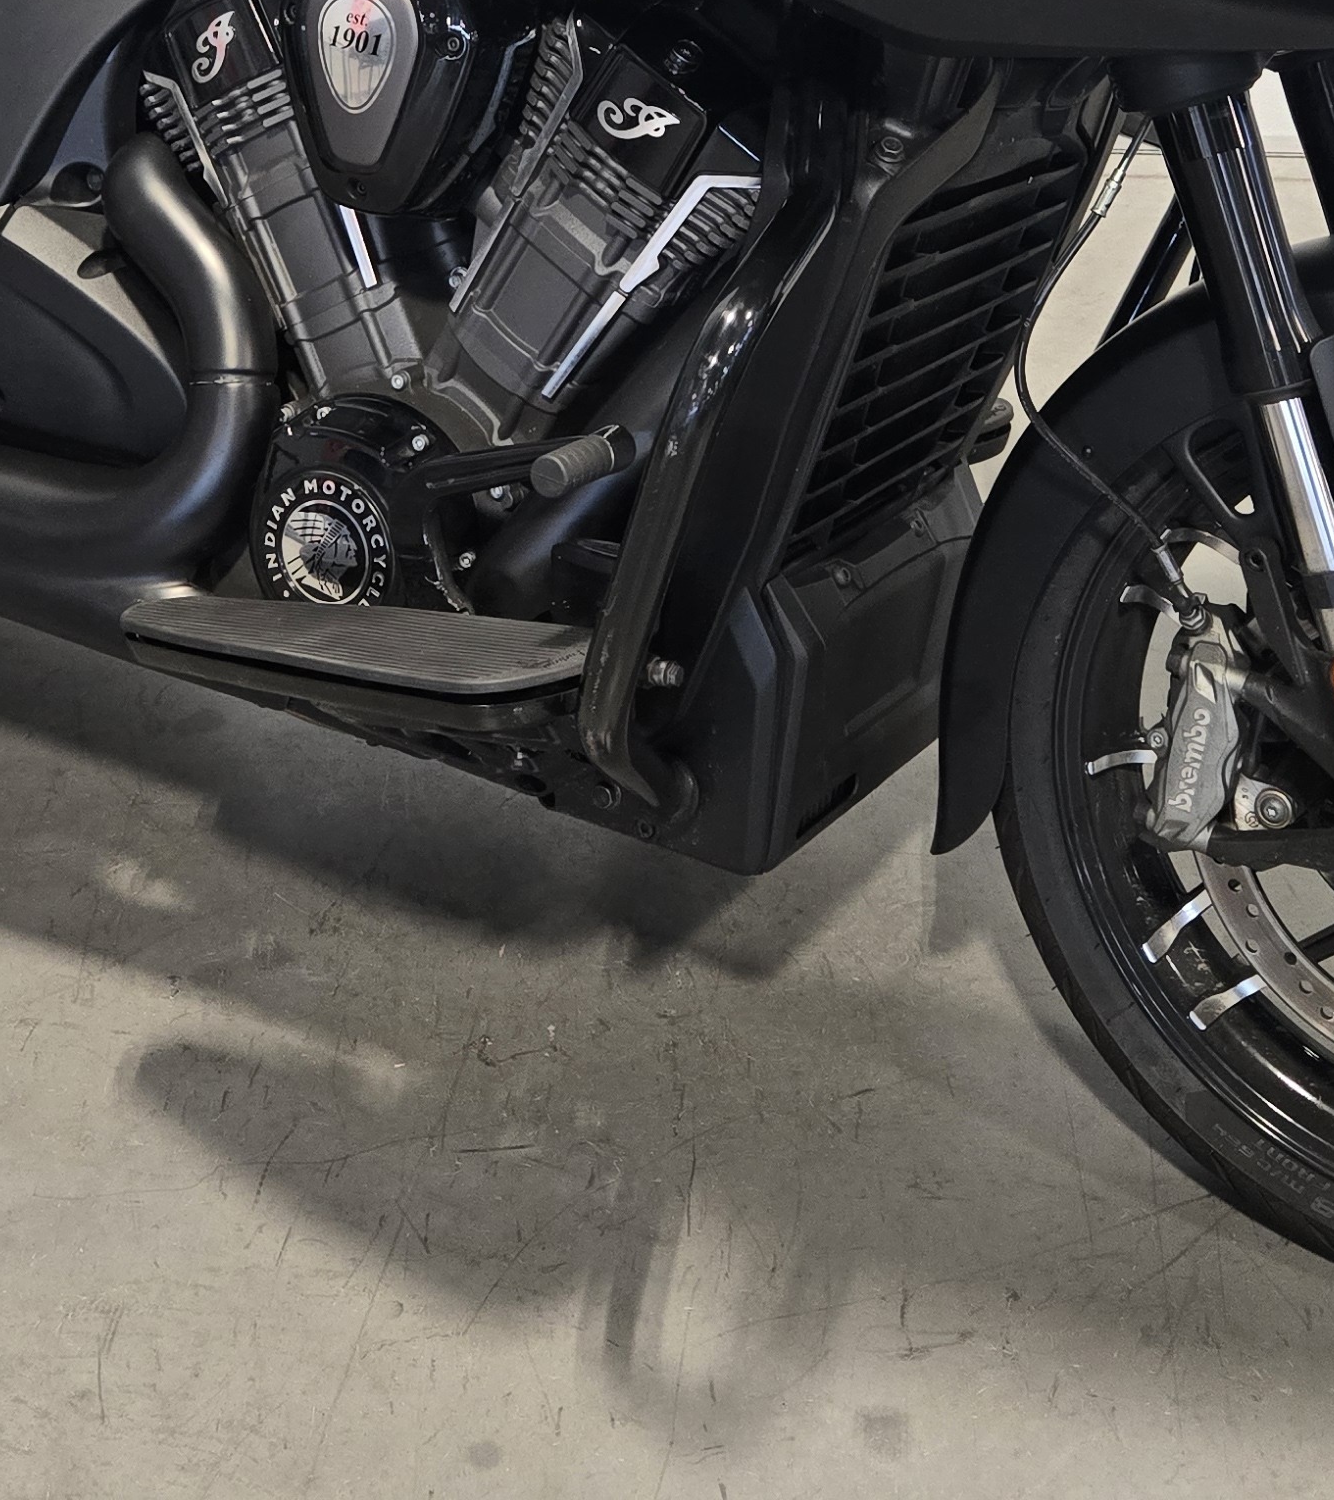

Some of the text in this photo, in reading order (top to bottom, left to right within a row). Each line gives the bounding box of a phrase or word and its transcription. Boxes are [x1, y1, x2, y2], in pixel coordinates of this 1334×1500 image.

[329, 25, 383, 57] 1901
[346, 12, 368, 27] est.
[264, 487, 297, 581] INDIAN
[1168, 708, 1212, 813] brembo
